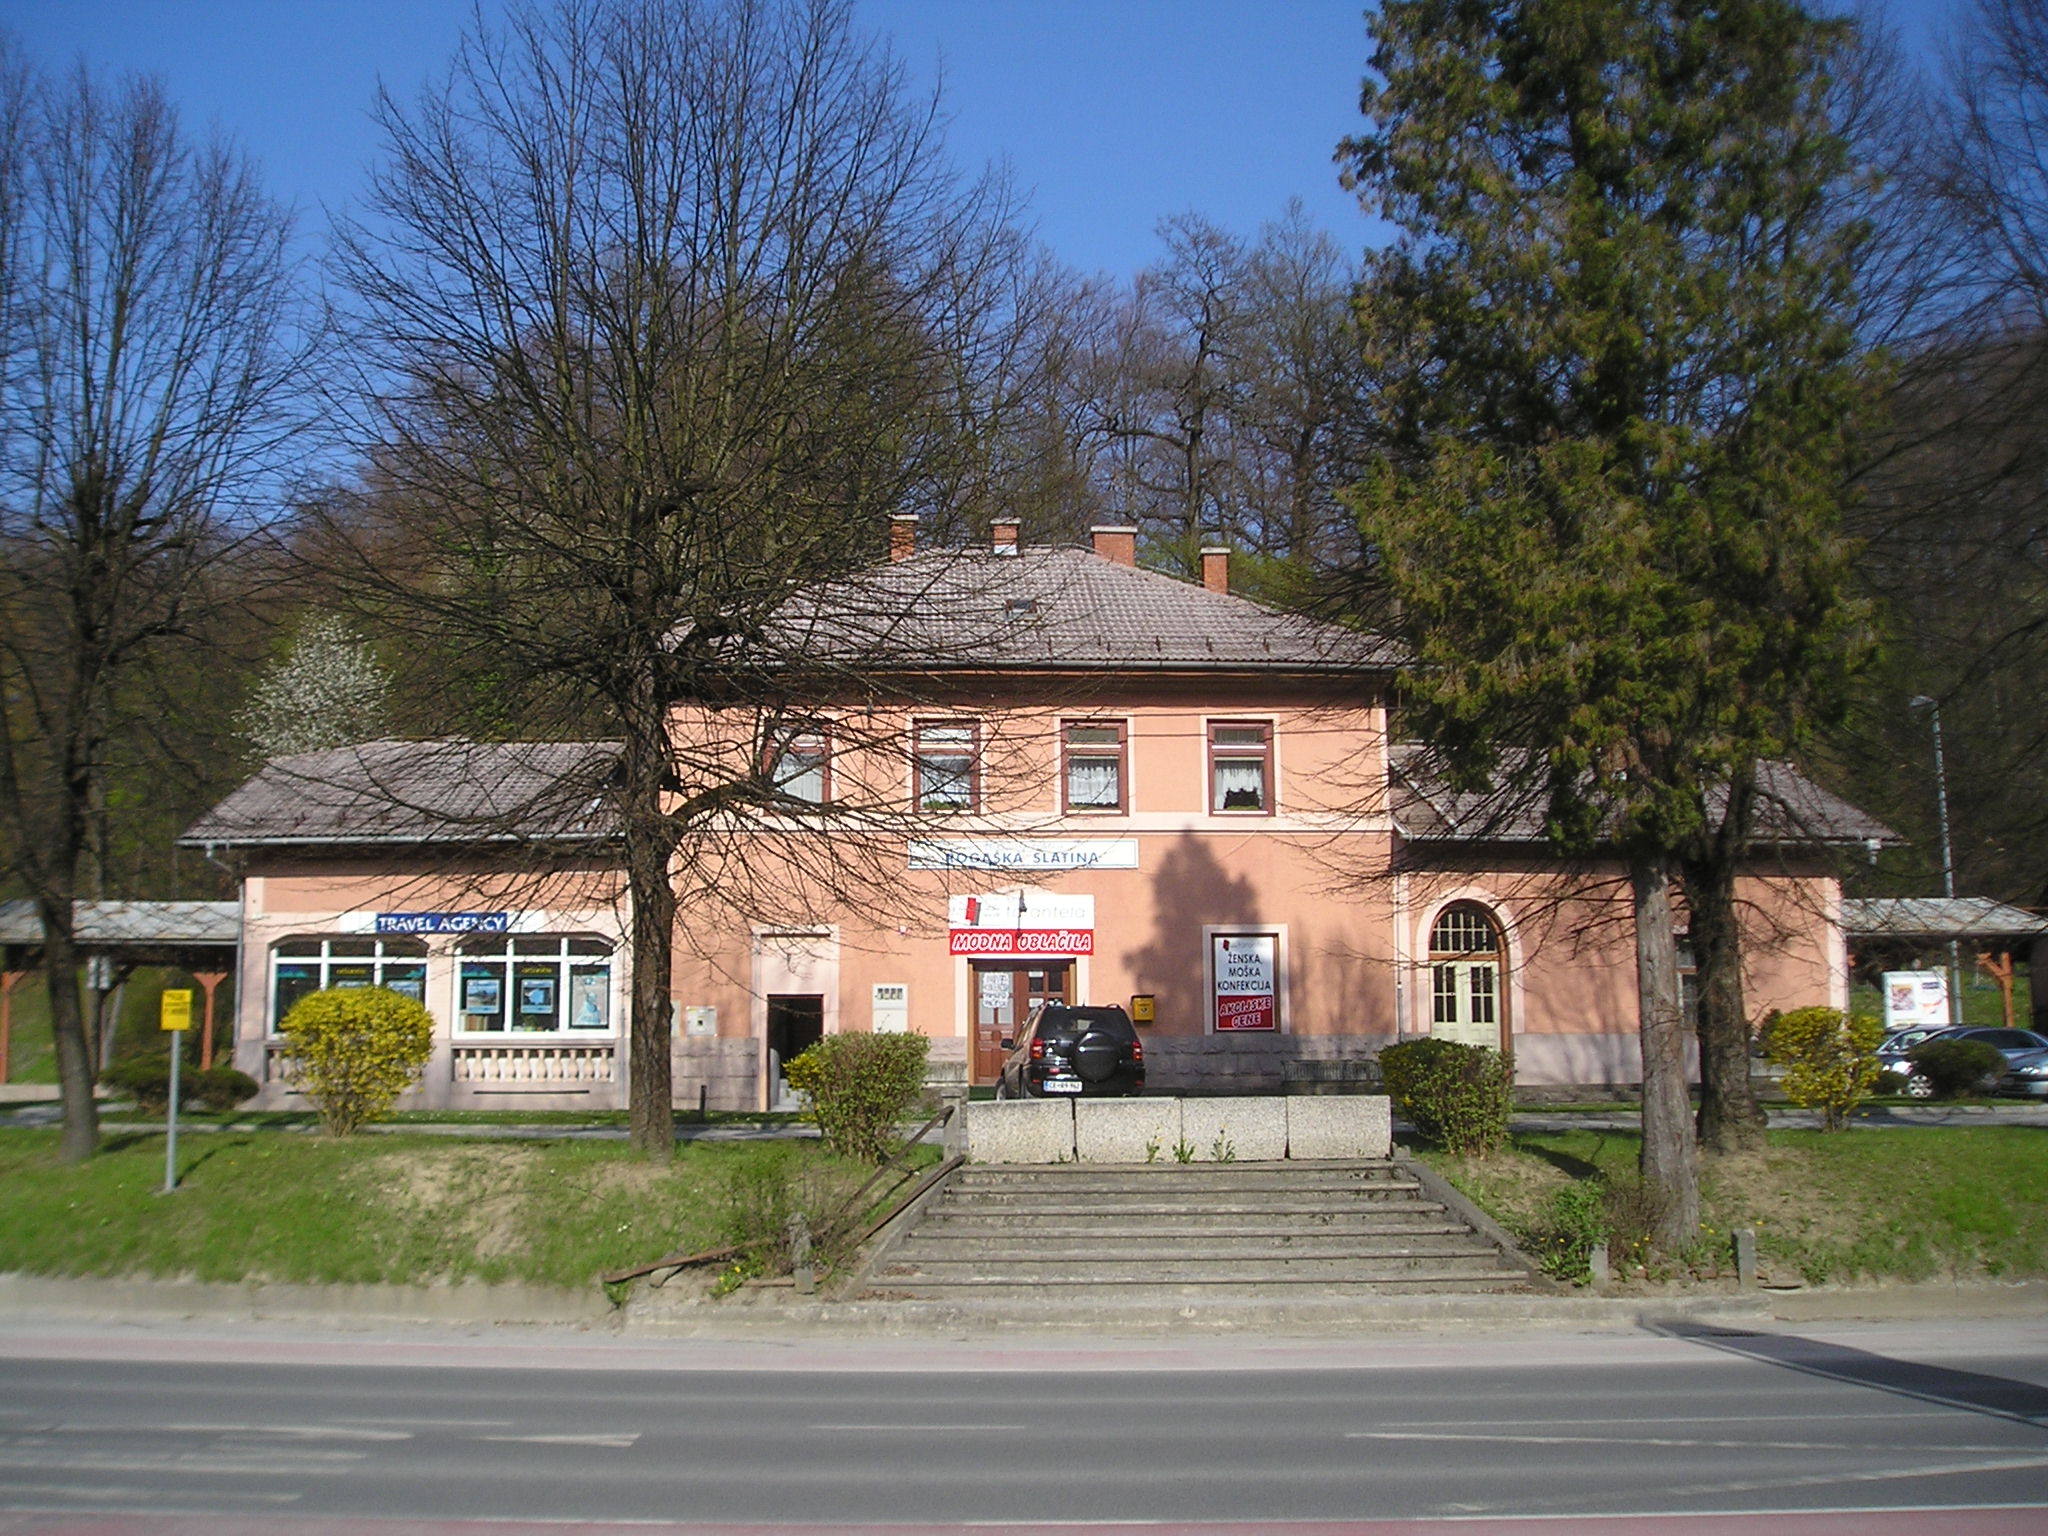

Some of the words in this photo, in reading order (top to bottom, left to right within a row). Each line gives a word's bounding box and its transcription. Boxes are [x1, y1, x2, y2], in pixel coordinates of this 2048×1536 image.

[1033, 852, 1099, 864] SLATINA
[1006, 904, 1085, 918] taantela
[379, 917, 434, 931] TRAVEL
[439, 917, 504, 931] AGENCY
[951, 933, 1012, 951] MODNA
[1018, 930, 1092, 951] OBLAČILA
[1228, 965, 1261, 977] MOŠKA
[1217, 981, 1271, 991] KONFEKCIJA
[1219, 997, 1272, 1016] AKCIJSKE
[1232, 1012, 1261, 1028] CENE
